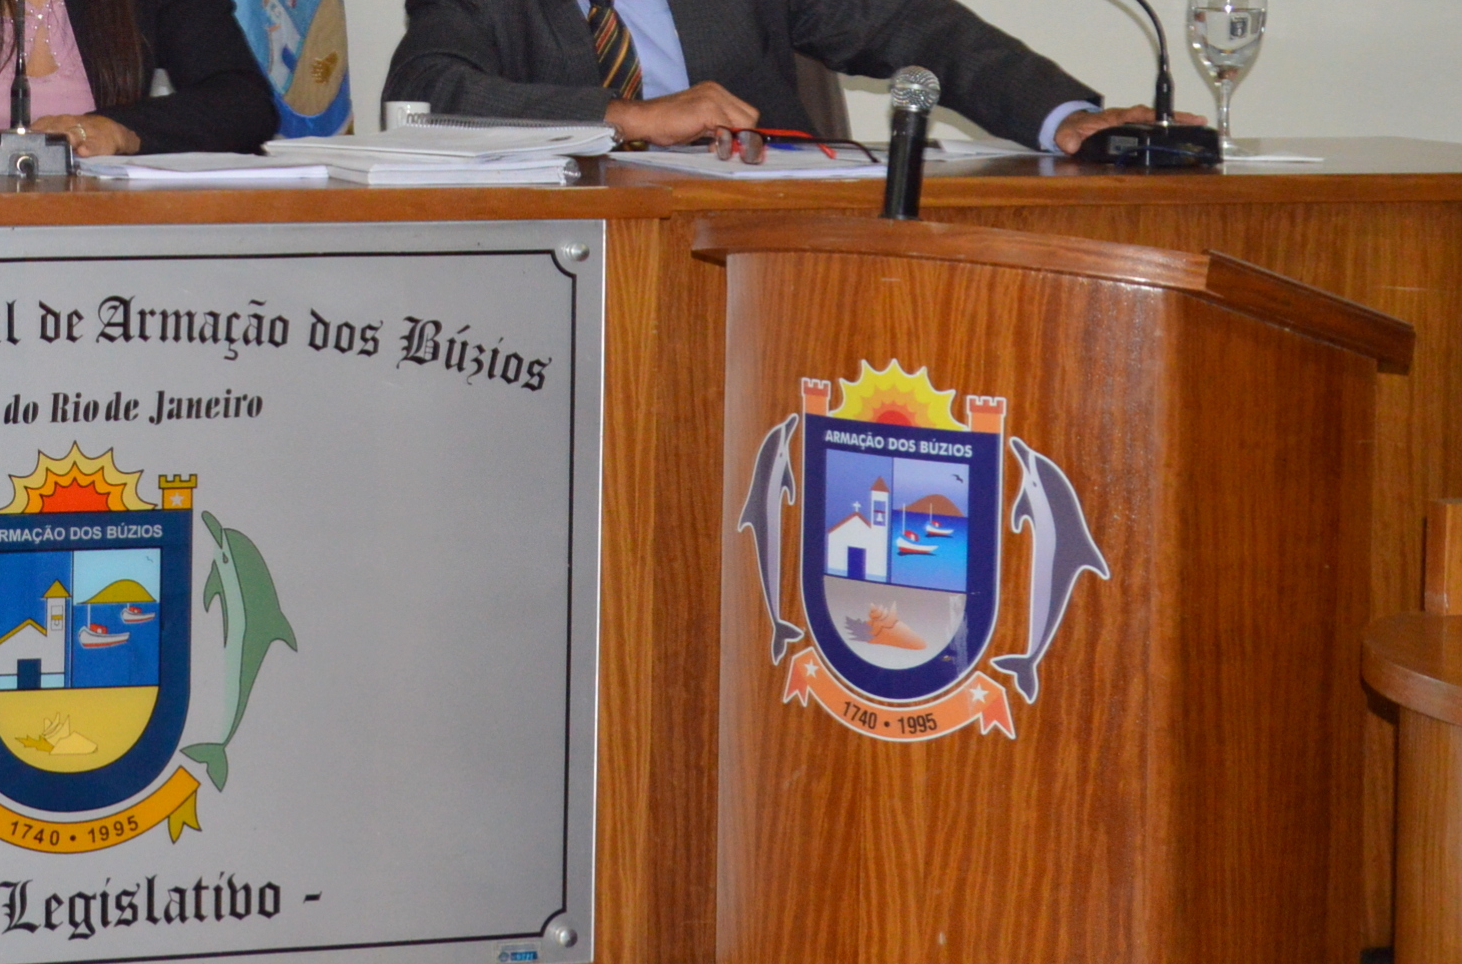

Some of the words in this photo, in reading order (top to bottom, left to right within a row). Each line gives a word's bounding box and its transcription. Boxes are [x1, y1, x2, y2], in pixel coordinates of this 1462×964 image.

[39, 300, 85, 344] de
[95, 295, 291, 361] Armação
[307, 308, 384, 357] dos
[396, 316, 553, 392] Búzios
[4, 393, 39, 425] do
[50, 392, 99, 424] Rio
[105, 390, 140, 422] de
[148, 388, 264, 426] Janeiro
[824, 429, 885, 451] ARMAÇÃO
[888, 436, 917, 454] DOS
[920, 436, 974, 459] BÚZIOS
[70, 526, 102, 540] DOS
[107, 522, 164, 540] BÚZIOS
[841, 700, 878, 731] 1740
[897, 712, 938, 735] 1995
[10, 820, 61, 847] 1740
[87, 815, 140, 844] 1995
